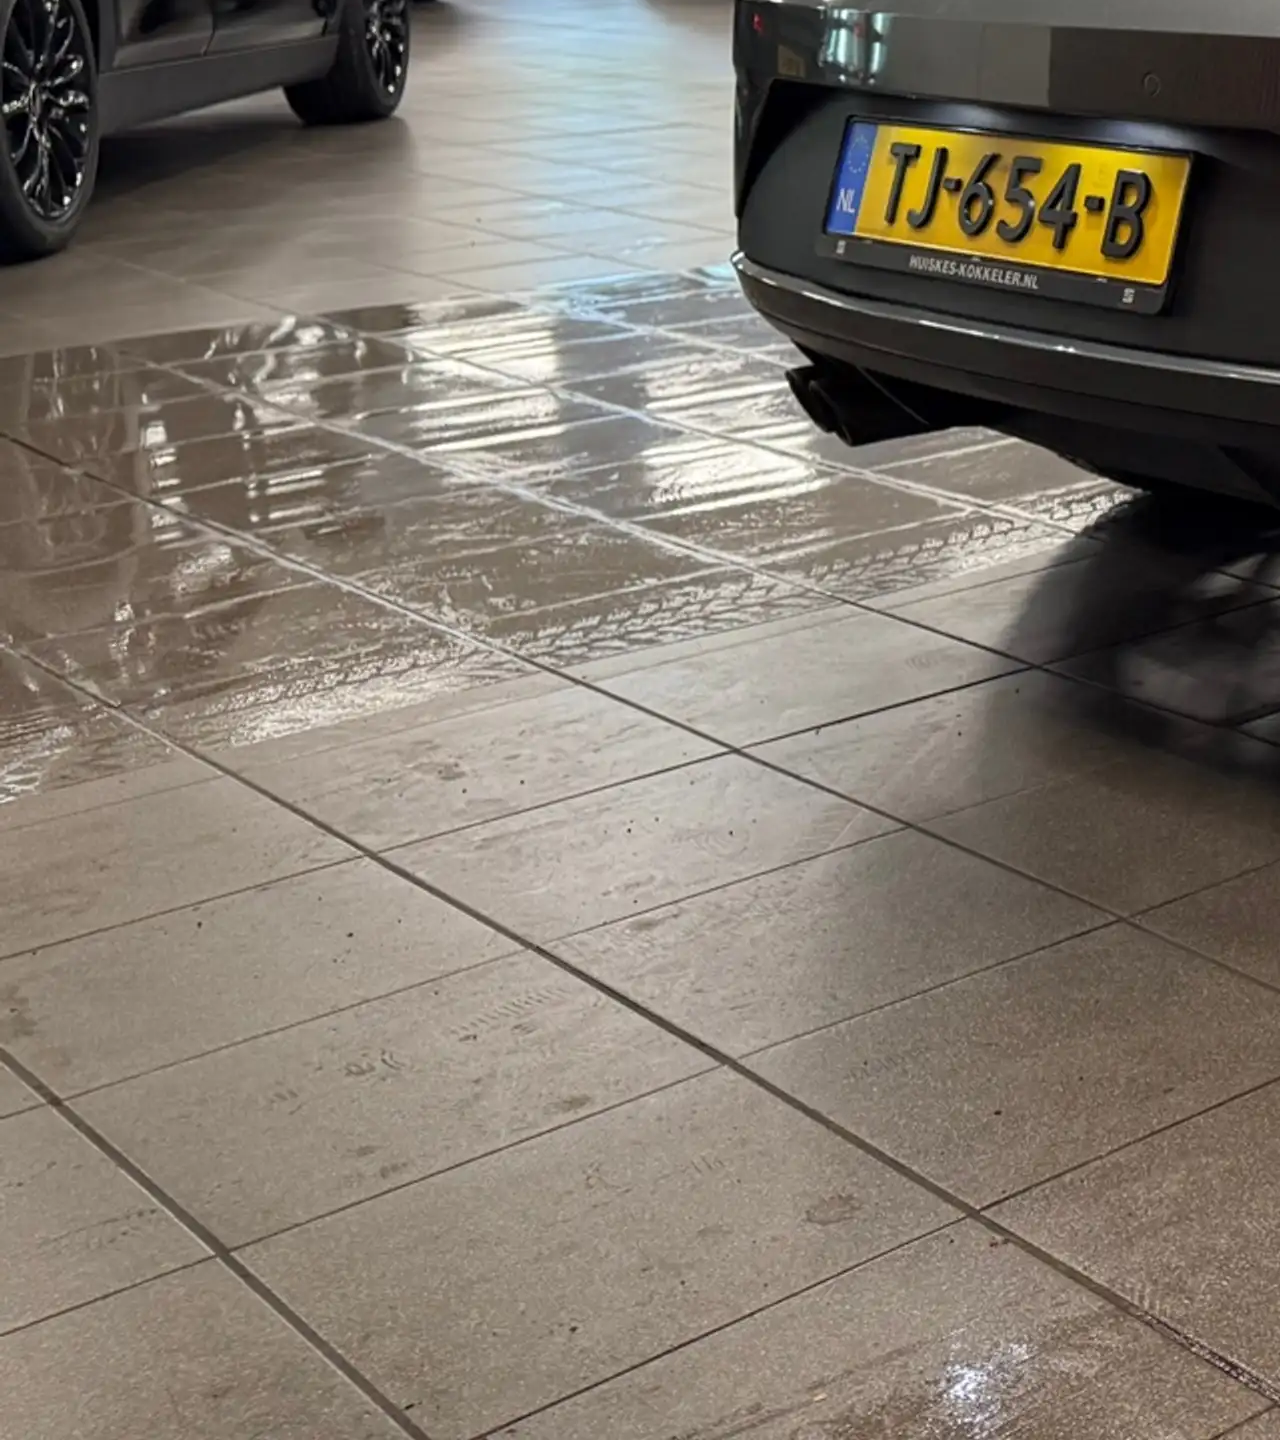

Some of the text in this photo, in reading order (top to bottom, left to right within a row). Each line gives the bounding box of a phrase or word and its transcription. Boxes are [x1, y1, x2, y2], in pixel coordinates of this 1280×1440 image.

[835, 188, 856, 214] NL
[883, 142, 1151, 259] TJ-654-B
[908, 254, 1039, 290] HUISKES-KOKKELER.NL
